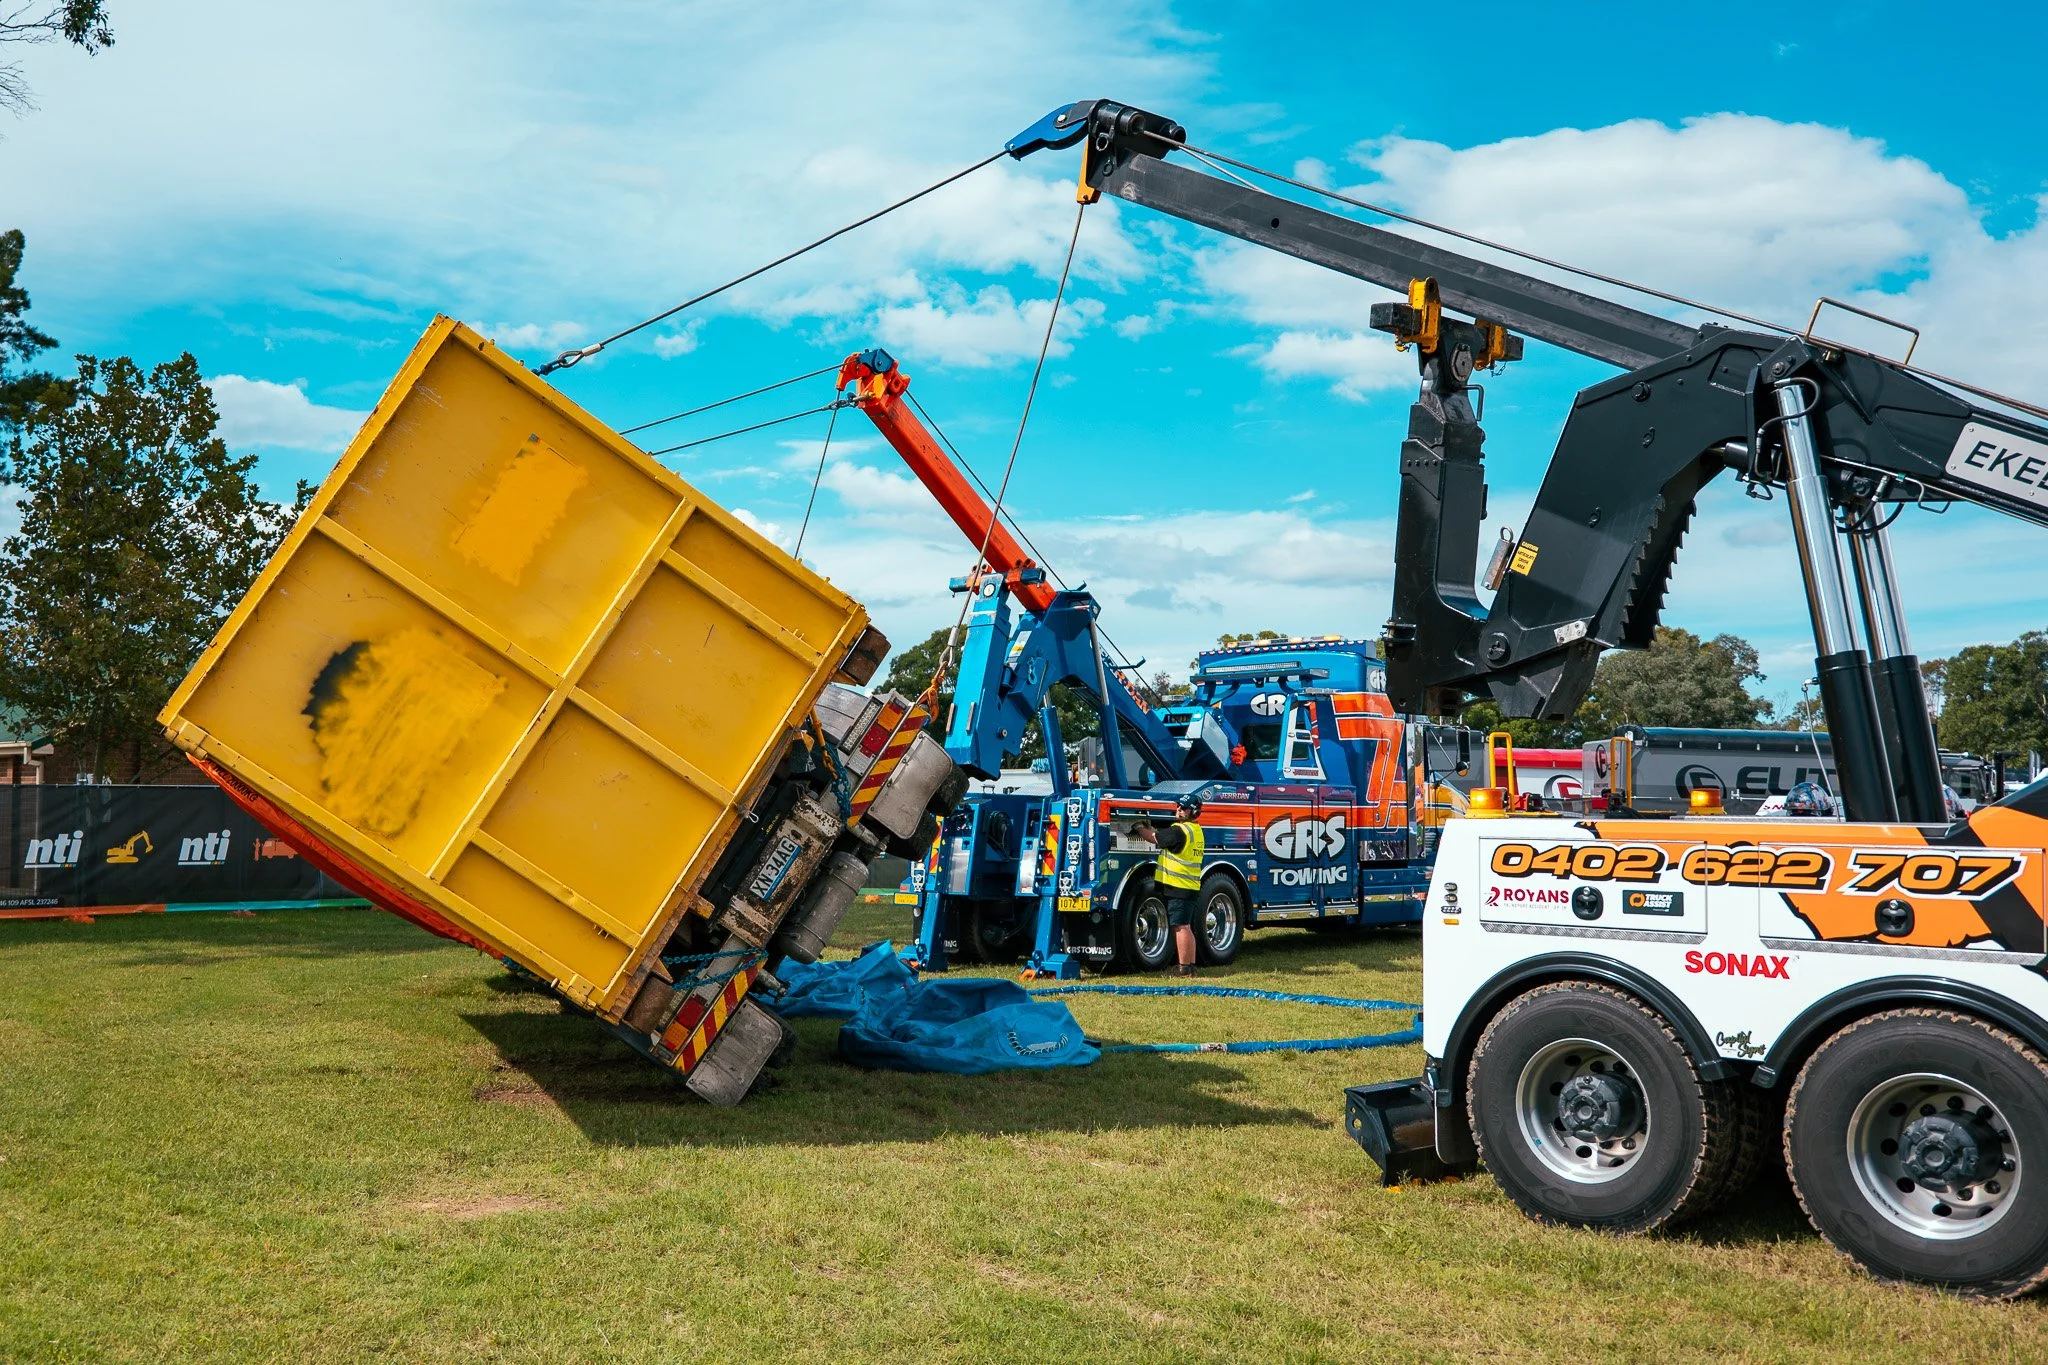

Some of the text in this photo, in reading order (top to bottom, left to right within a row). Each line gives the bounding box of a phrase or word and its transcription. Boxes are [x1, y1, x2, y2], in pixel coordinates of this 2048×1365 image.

[24, 830, 84, 864] nti
[178, 829, 231, 861] nti
[1264, 815, 1346, 860] GRS
[1269, 866, 1348, 886] TOWING
[1490, 843, 2021, 896] 0402 622 707
[1503, 888, 1569, 904] ROYANS
[1645, 893, 1673, 902] TRUCK
[1684, 950, 1790, 979] SONAX
